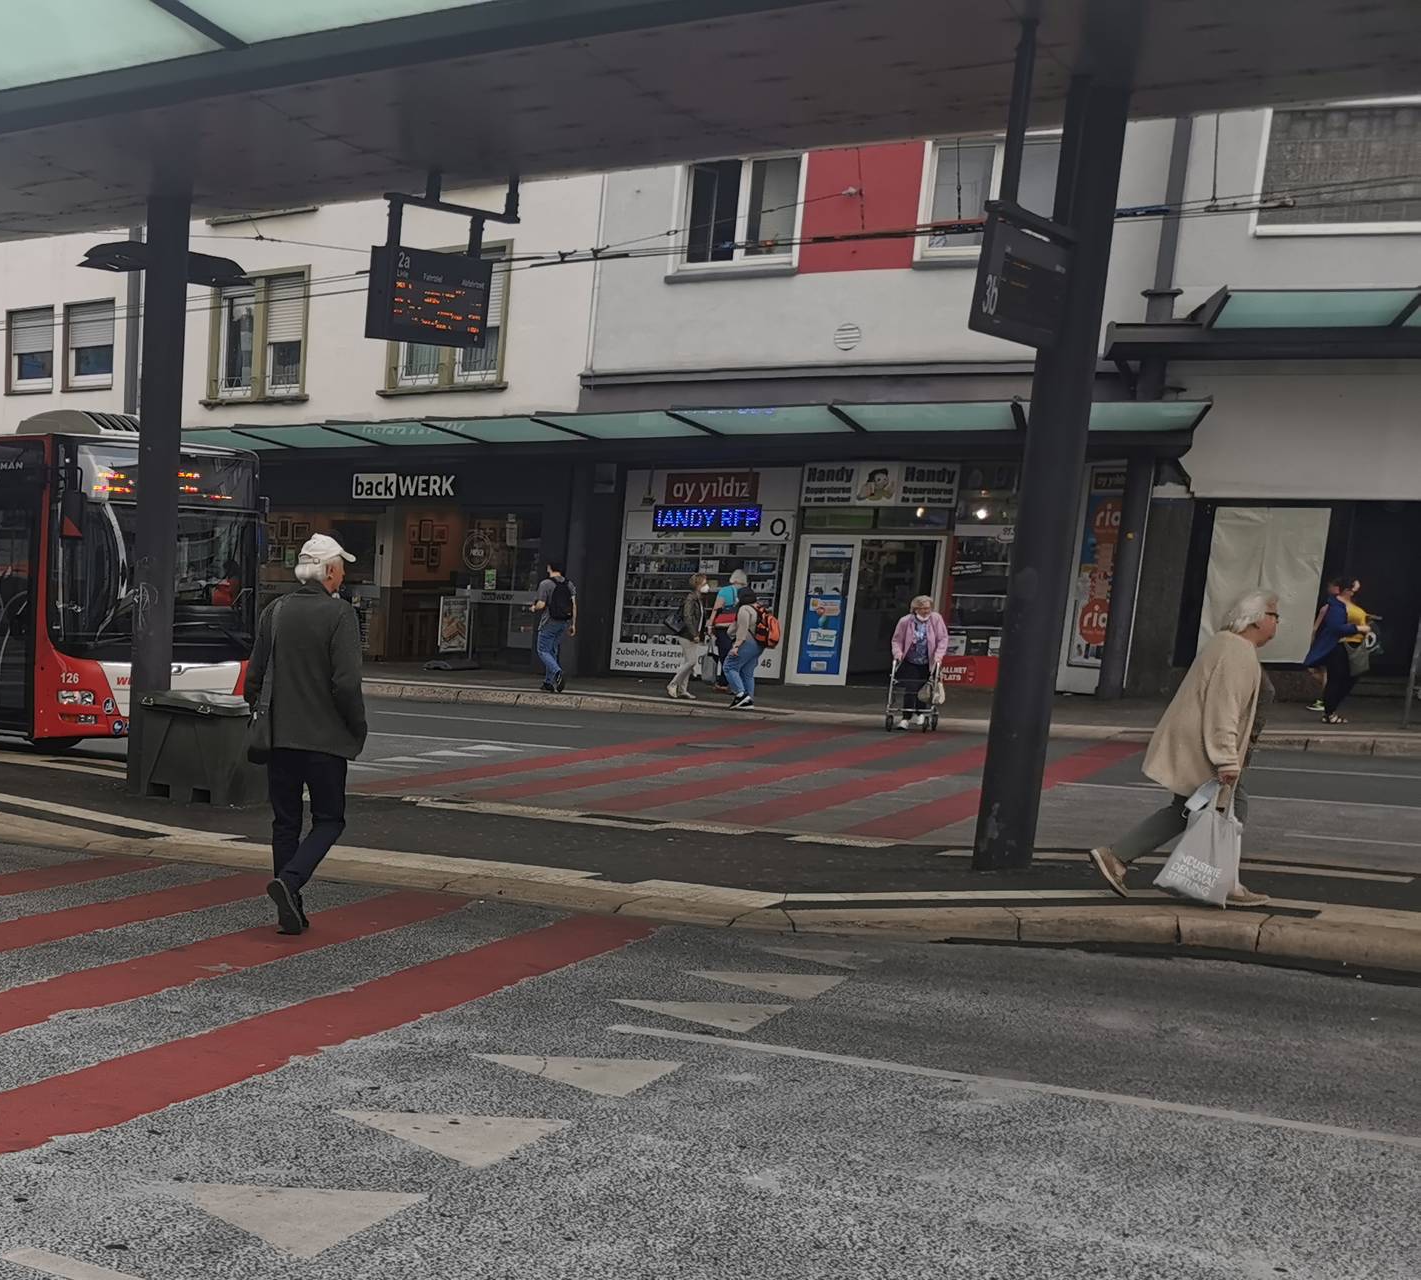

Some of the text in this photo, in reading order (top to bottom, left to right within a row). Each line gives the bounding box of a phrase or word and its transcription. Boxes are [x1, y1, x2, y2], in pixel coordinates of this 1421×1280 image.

[398, 251, 410, 269] 2a
[0, 461, 24, 470] MAN
[807, 467, 854, 483] Handy
[904, 466, 956, 484] Handy
[354, 474, 456, 498] backWERK
[673, 482, 696, 503] ay
[616, 647, 649, 658] Zubehör,
[614, 658, 652, 669] Reparatur
[653, 660, 659, 668] &
[60, 672, 80, 684] 126
